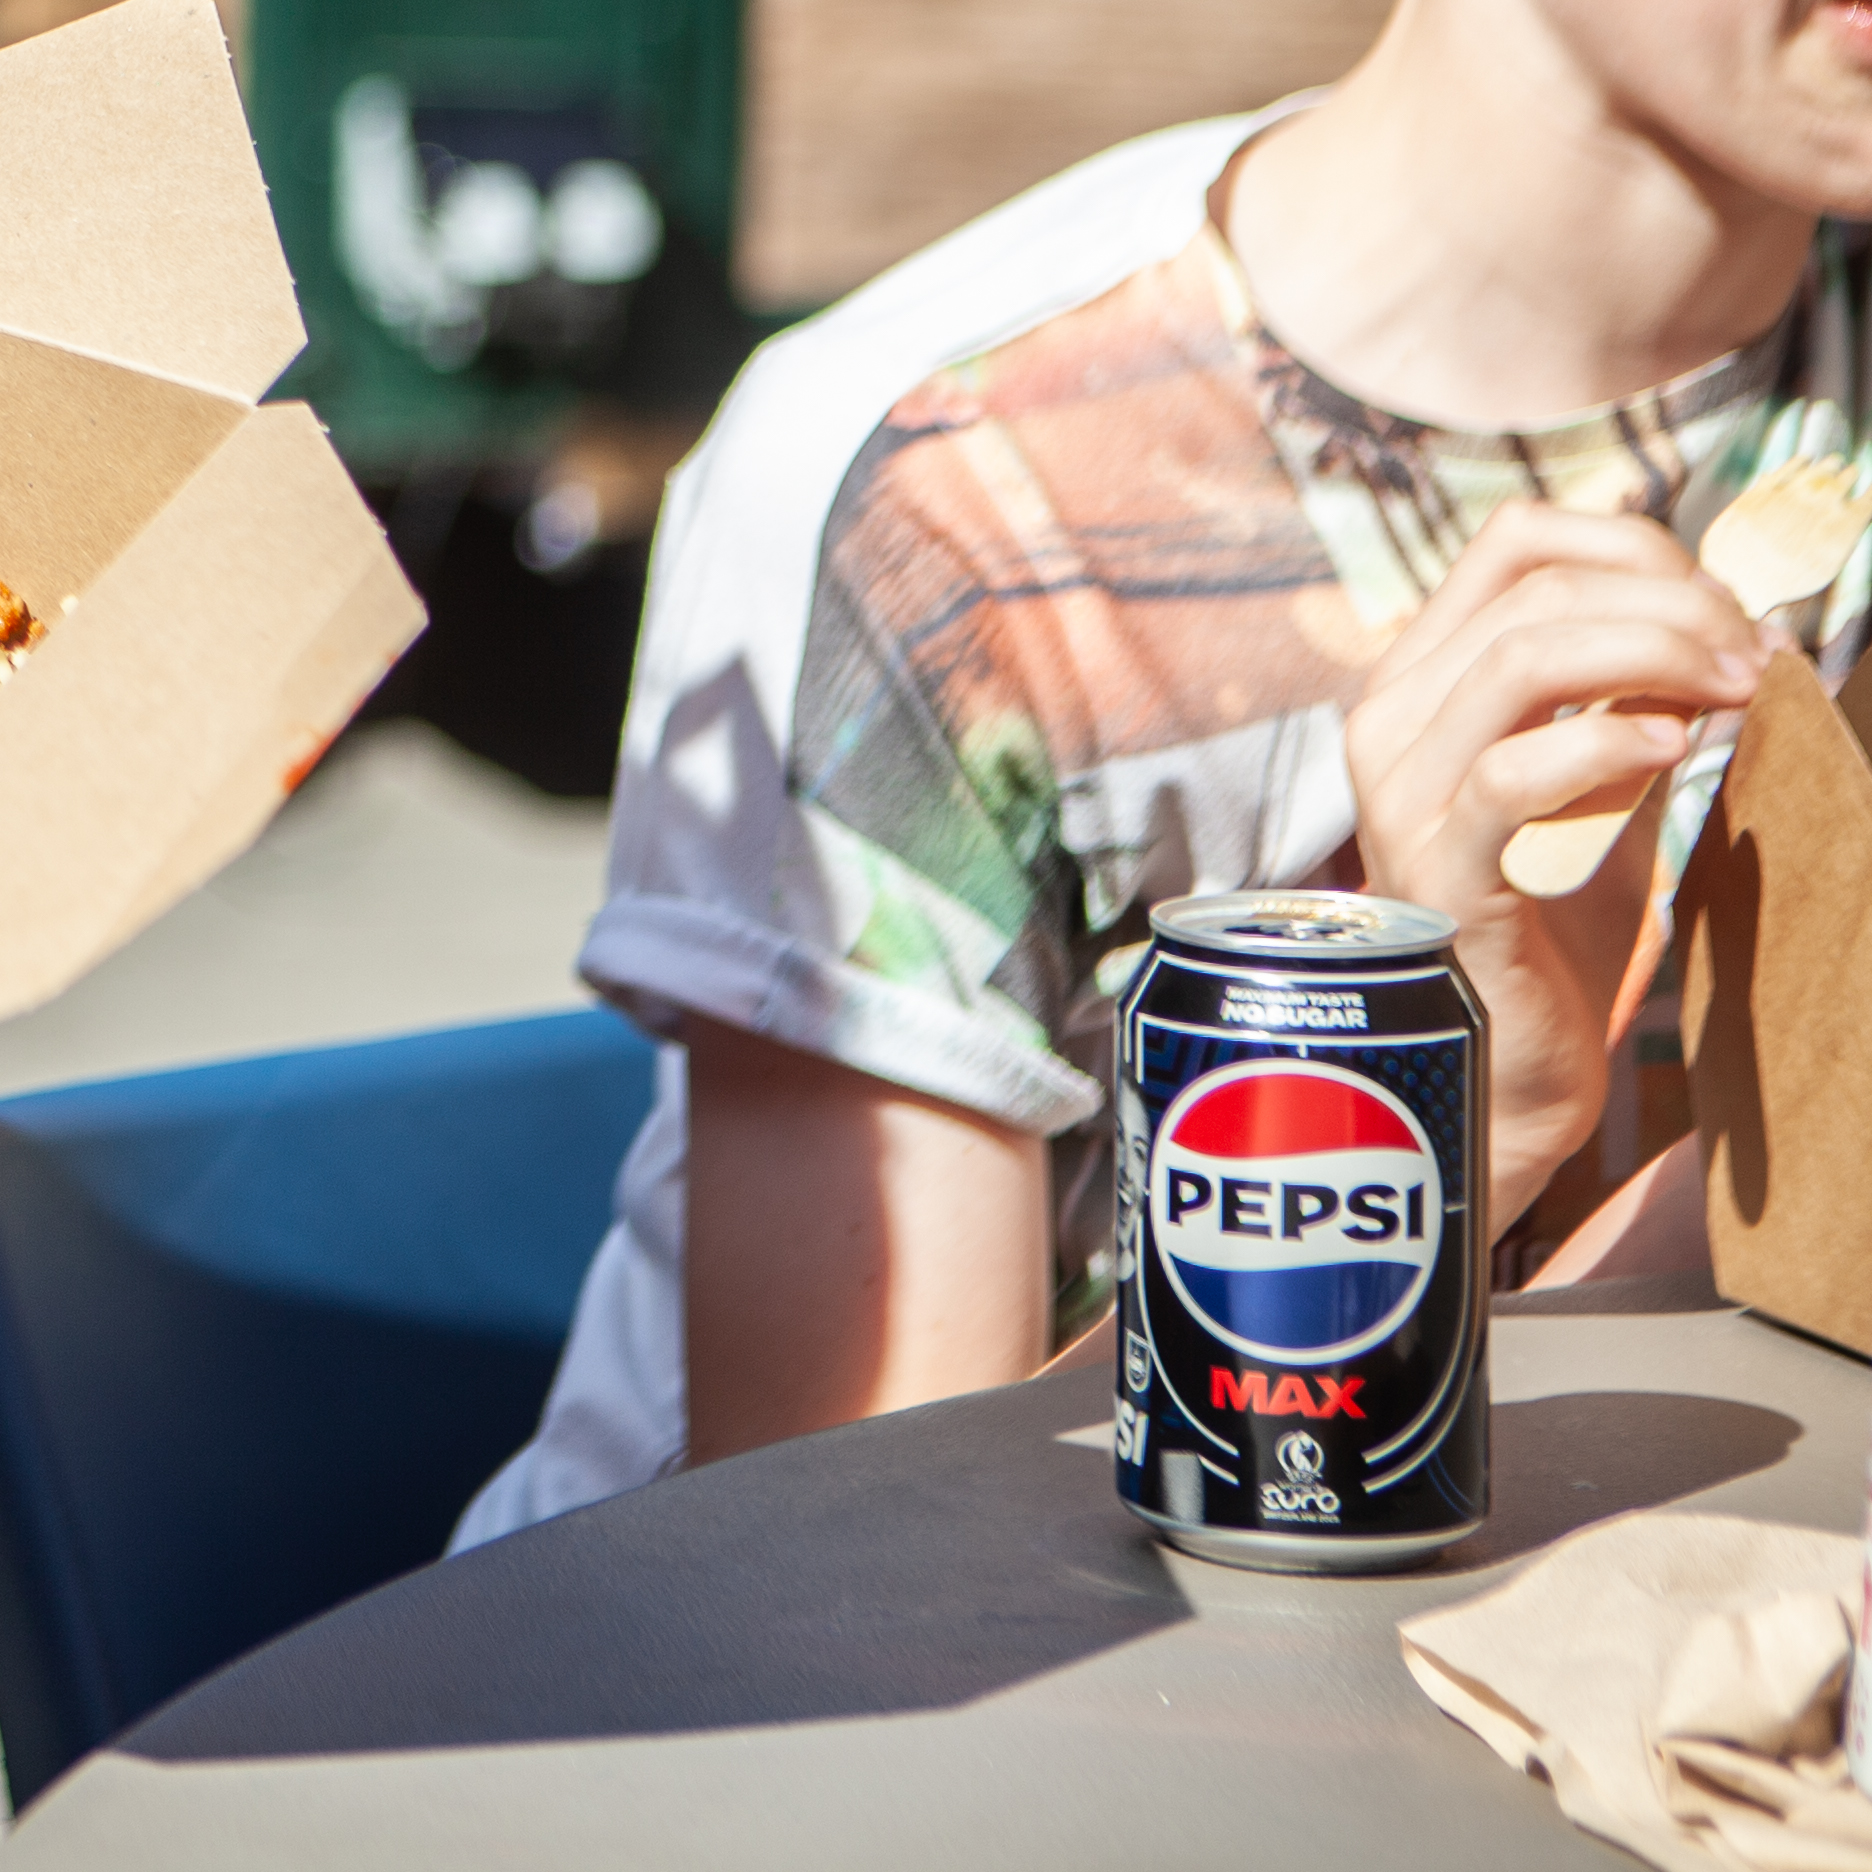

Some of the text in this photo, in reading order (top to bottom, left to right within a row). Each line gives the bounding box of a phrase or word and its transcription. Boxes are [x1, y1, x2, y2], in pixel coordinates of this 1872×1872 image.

[1220, 999, 1266, 1024] NO
[1307, 992, 1366, 1009] TASTE
[1167, 1167, 1425, 1243] PEPSI
[1210, 1365, 1368, 1419] MAX
